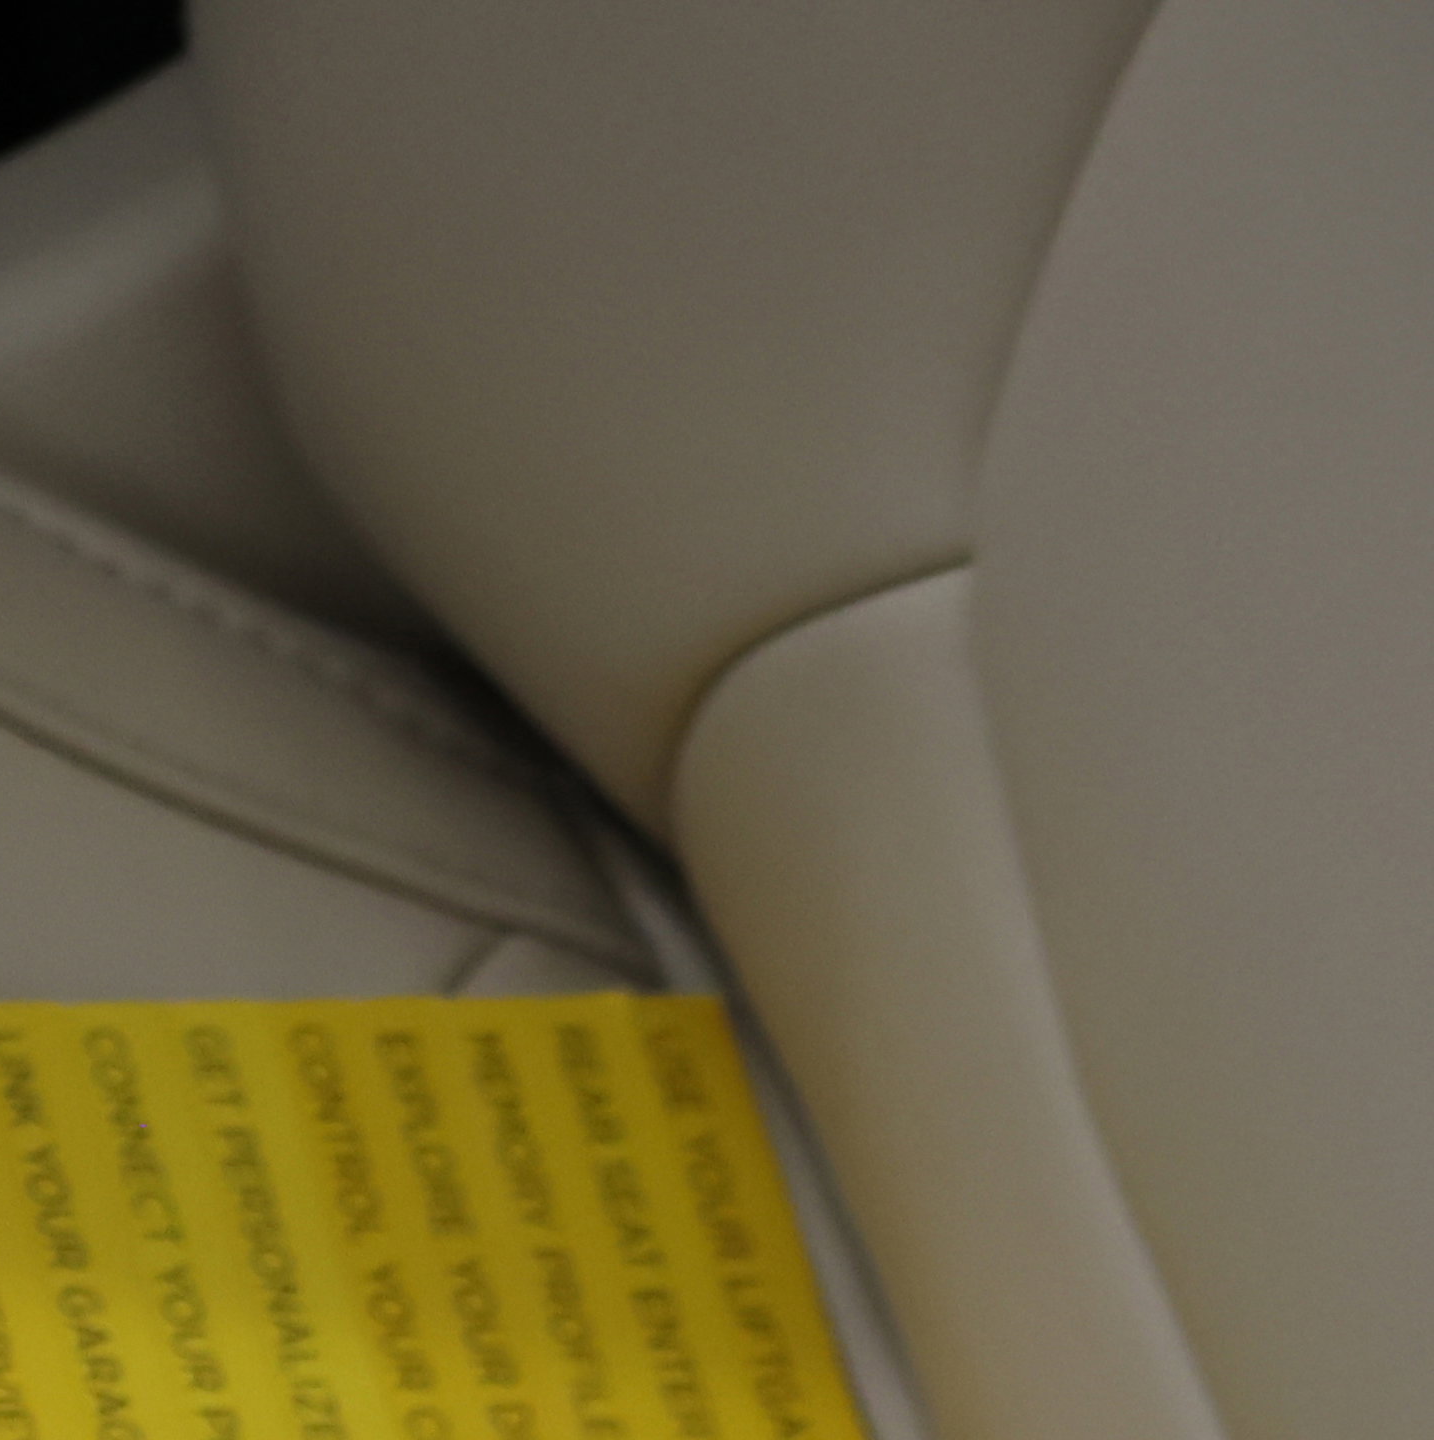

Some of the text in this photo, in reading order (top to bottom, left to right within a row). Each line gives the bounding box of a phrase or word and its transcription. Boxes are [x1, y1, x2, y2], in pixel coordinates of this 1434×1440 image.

[23, 1144, 91, 1271] YOUR
[82, 1028, 183, 1242] CONNECT
[157, 1265, 225, 1391] YOUR
[184, 1026, 248, 1108] GET
[286, 1023, 384, 1240] CONTROL
[365, 1264, 437, 1391] YOUR
[375, 1031, 478, 1232] EXPLORE
[450, 1259, 518, 1386] YOUR
